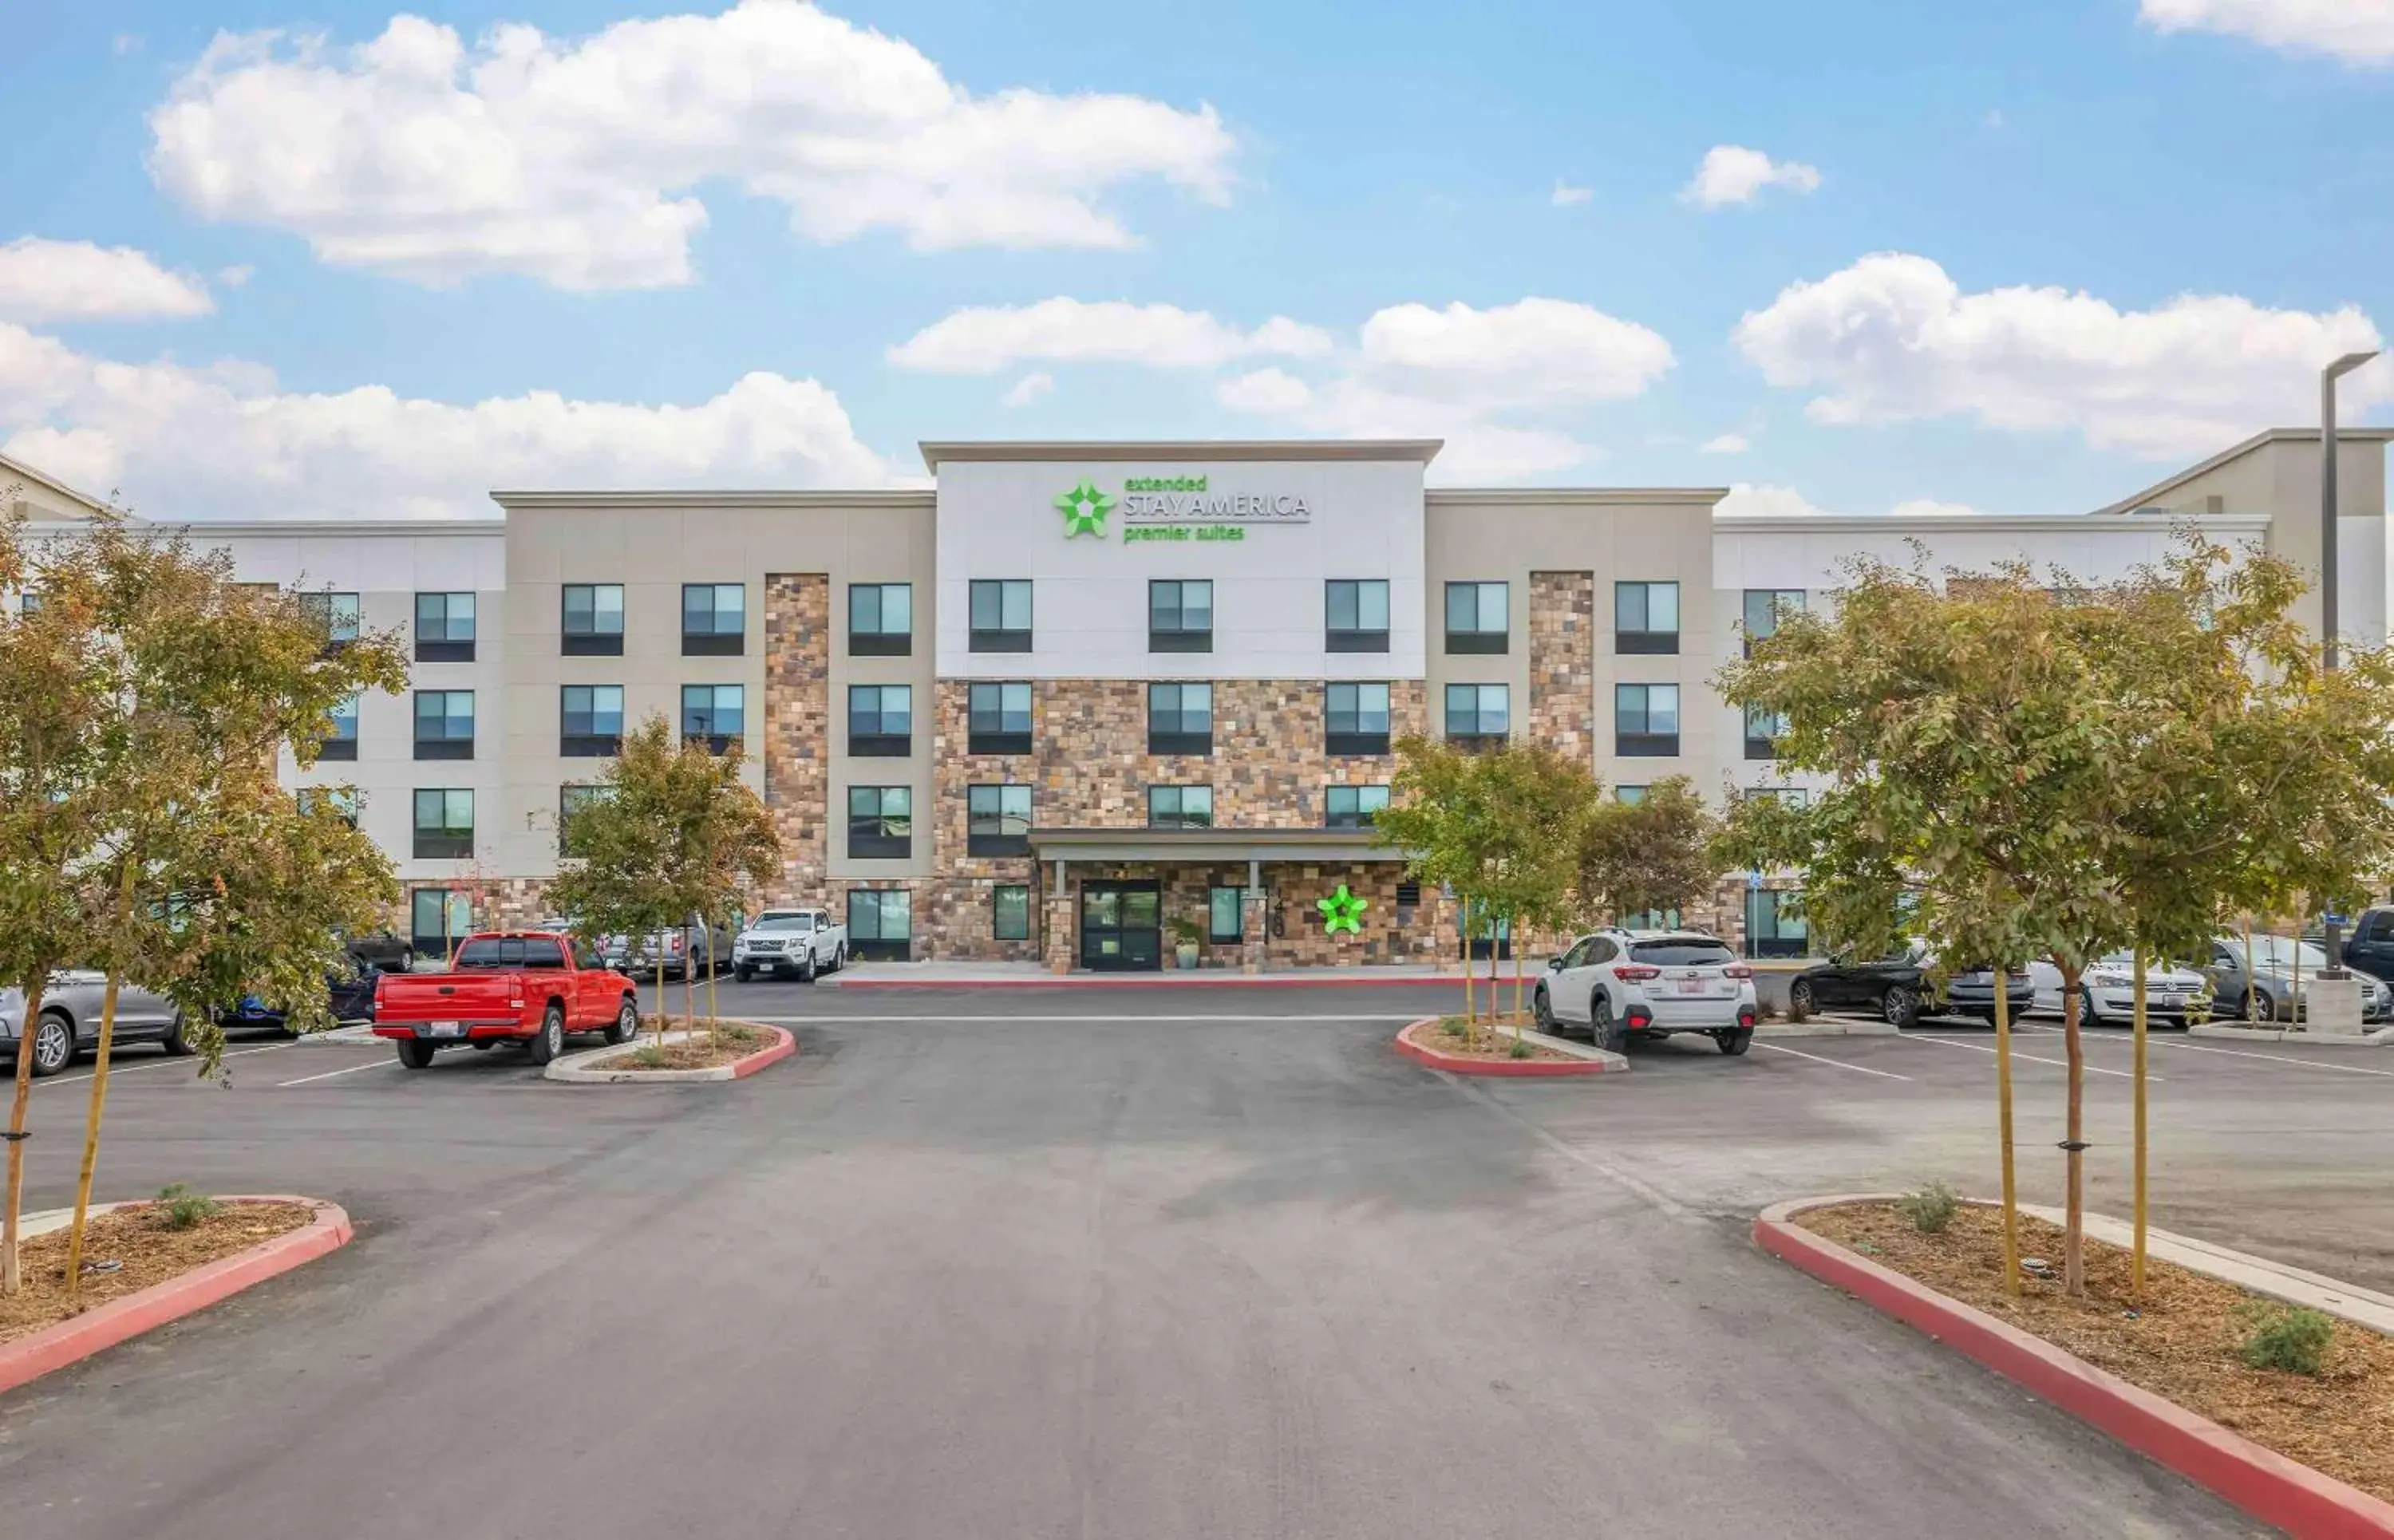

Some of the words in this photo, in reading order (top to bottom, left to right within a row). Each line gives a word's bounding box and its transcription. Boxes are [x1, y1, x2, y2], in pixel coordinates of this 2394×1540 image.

[1124, 474, 1207, 492] extended
[1124, 496, 1185, 516] STAY
[1187, 495, 1310, 516] AMERICA
[1124, 525, 1190, 545] premier
[1196, 524, 1244, 540] suites
